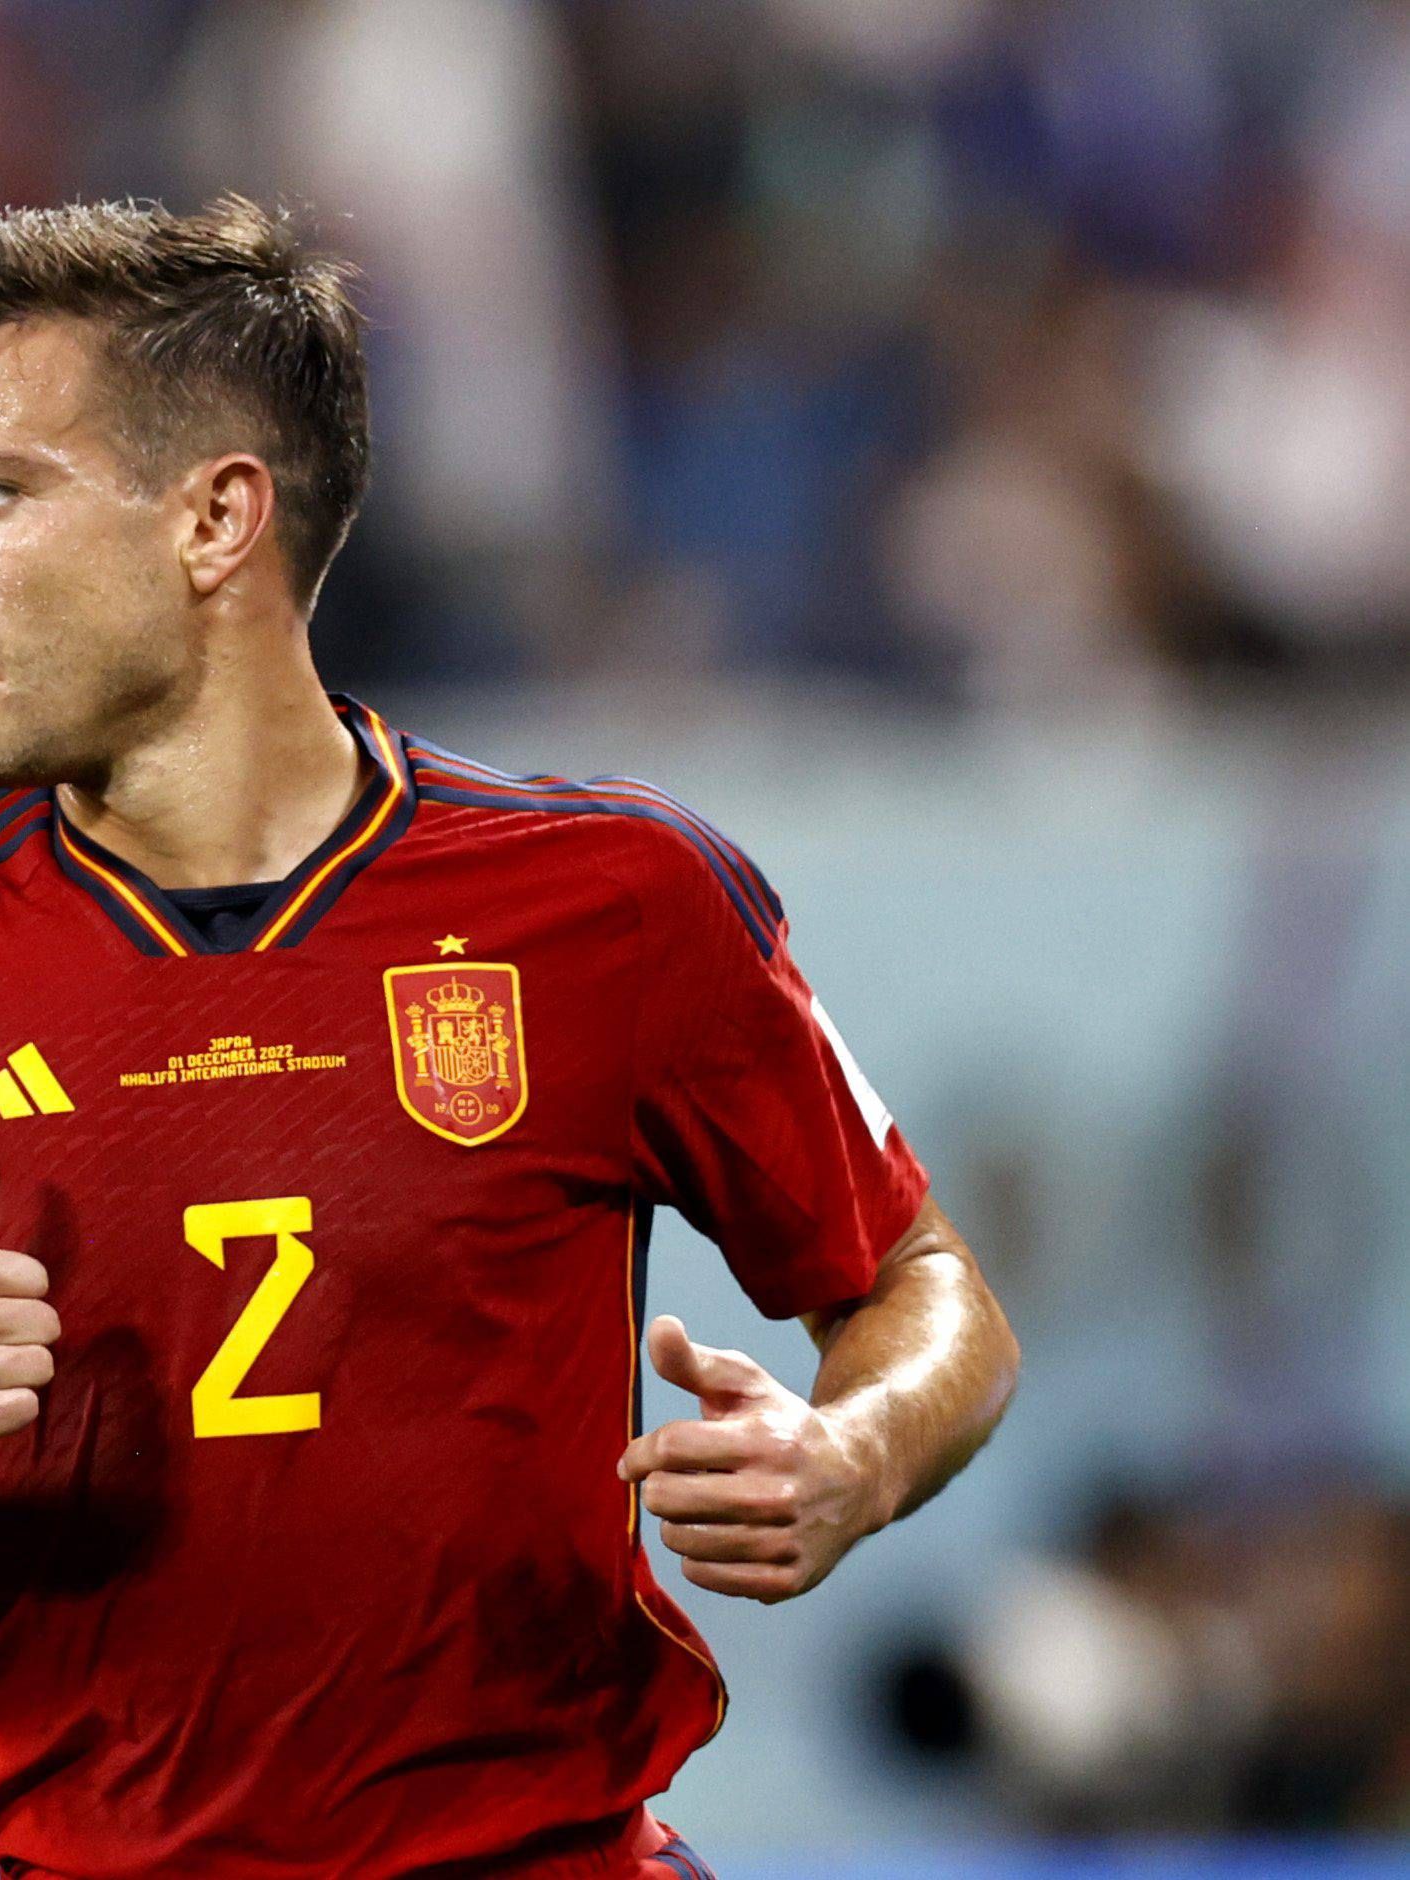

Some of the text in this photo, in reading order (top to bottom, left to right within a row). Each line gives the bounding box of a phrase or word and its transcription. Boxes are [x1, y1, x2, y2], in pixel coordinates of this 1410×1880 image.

[168, 1044, 294, 1069] 01 DECEMBER 2022
[209, 1035, 252, 1051] JAPAN
[120, 1055, 347, 1086] KHALIFA INTERNATIONAL STADIUM
[183, 1196, 321, 1439] 2
